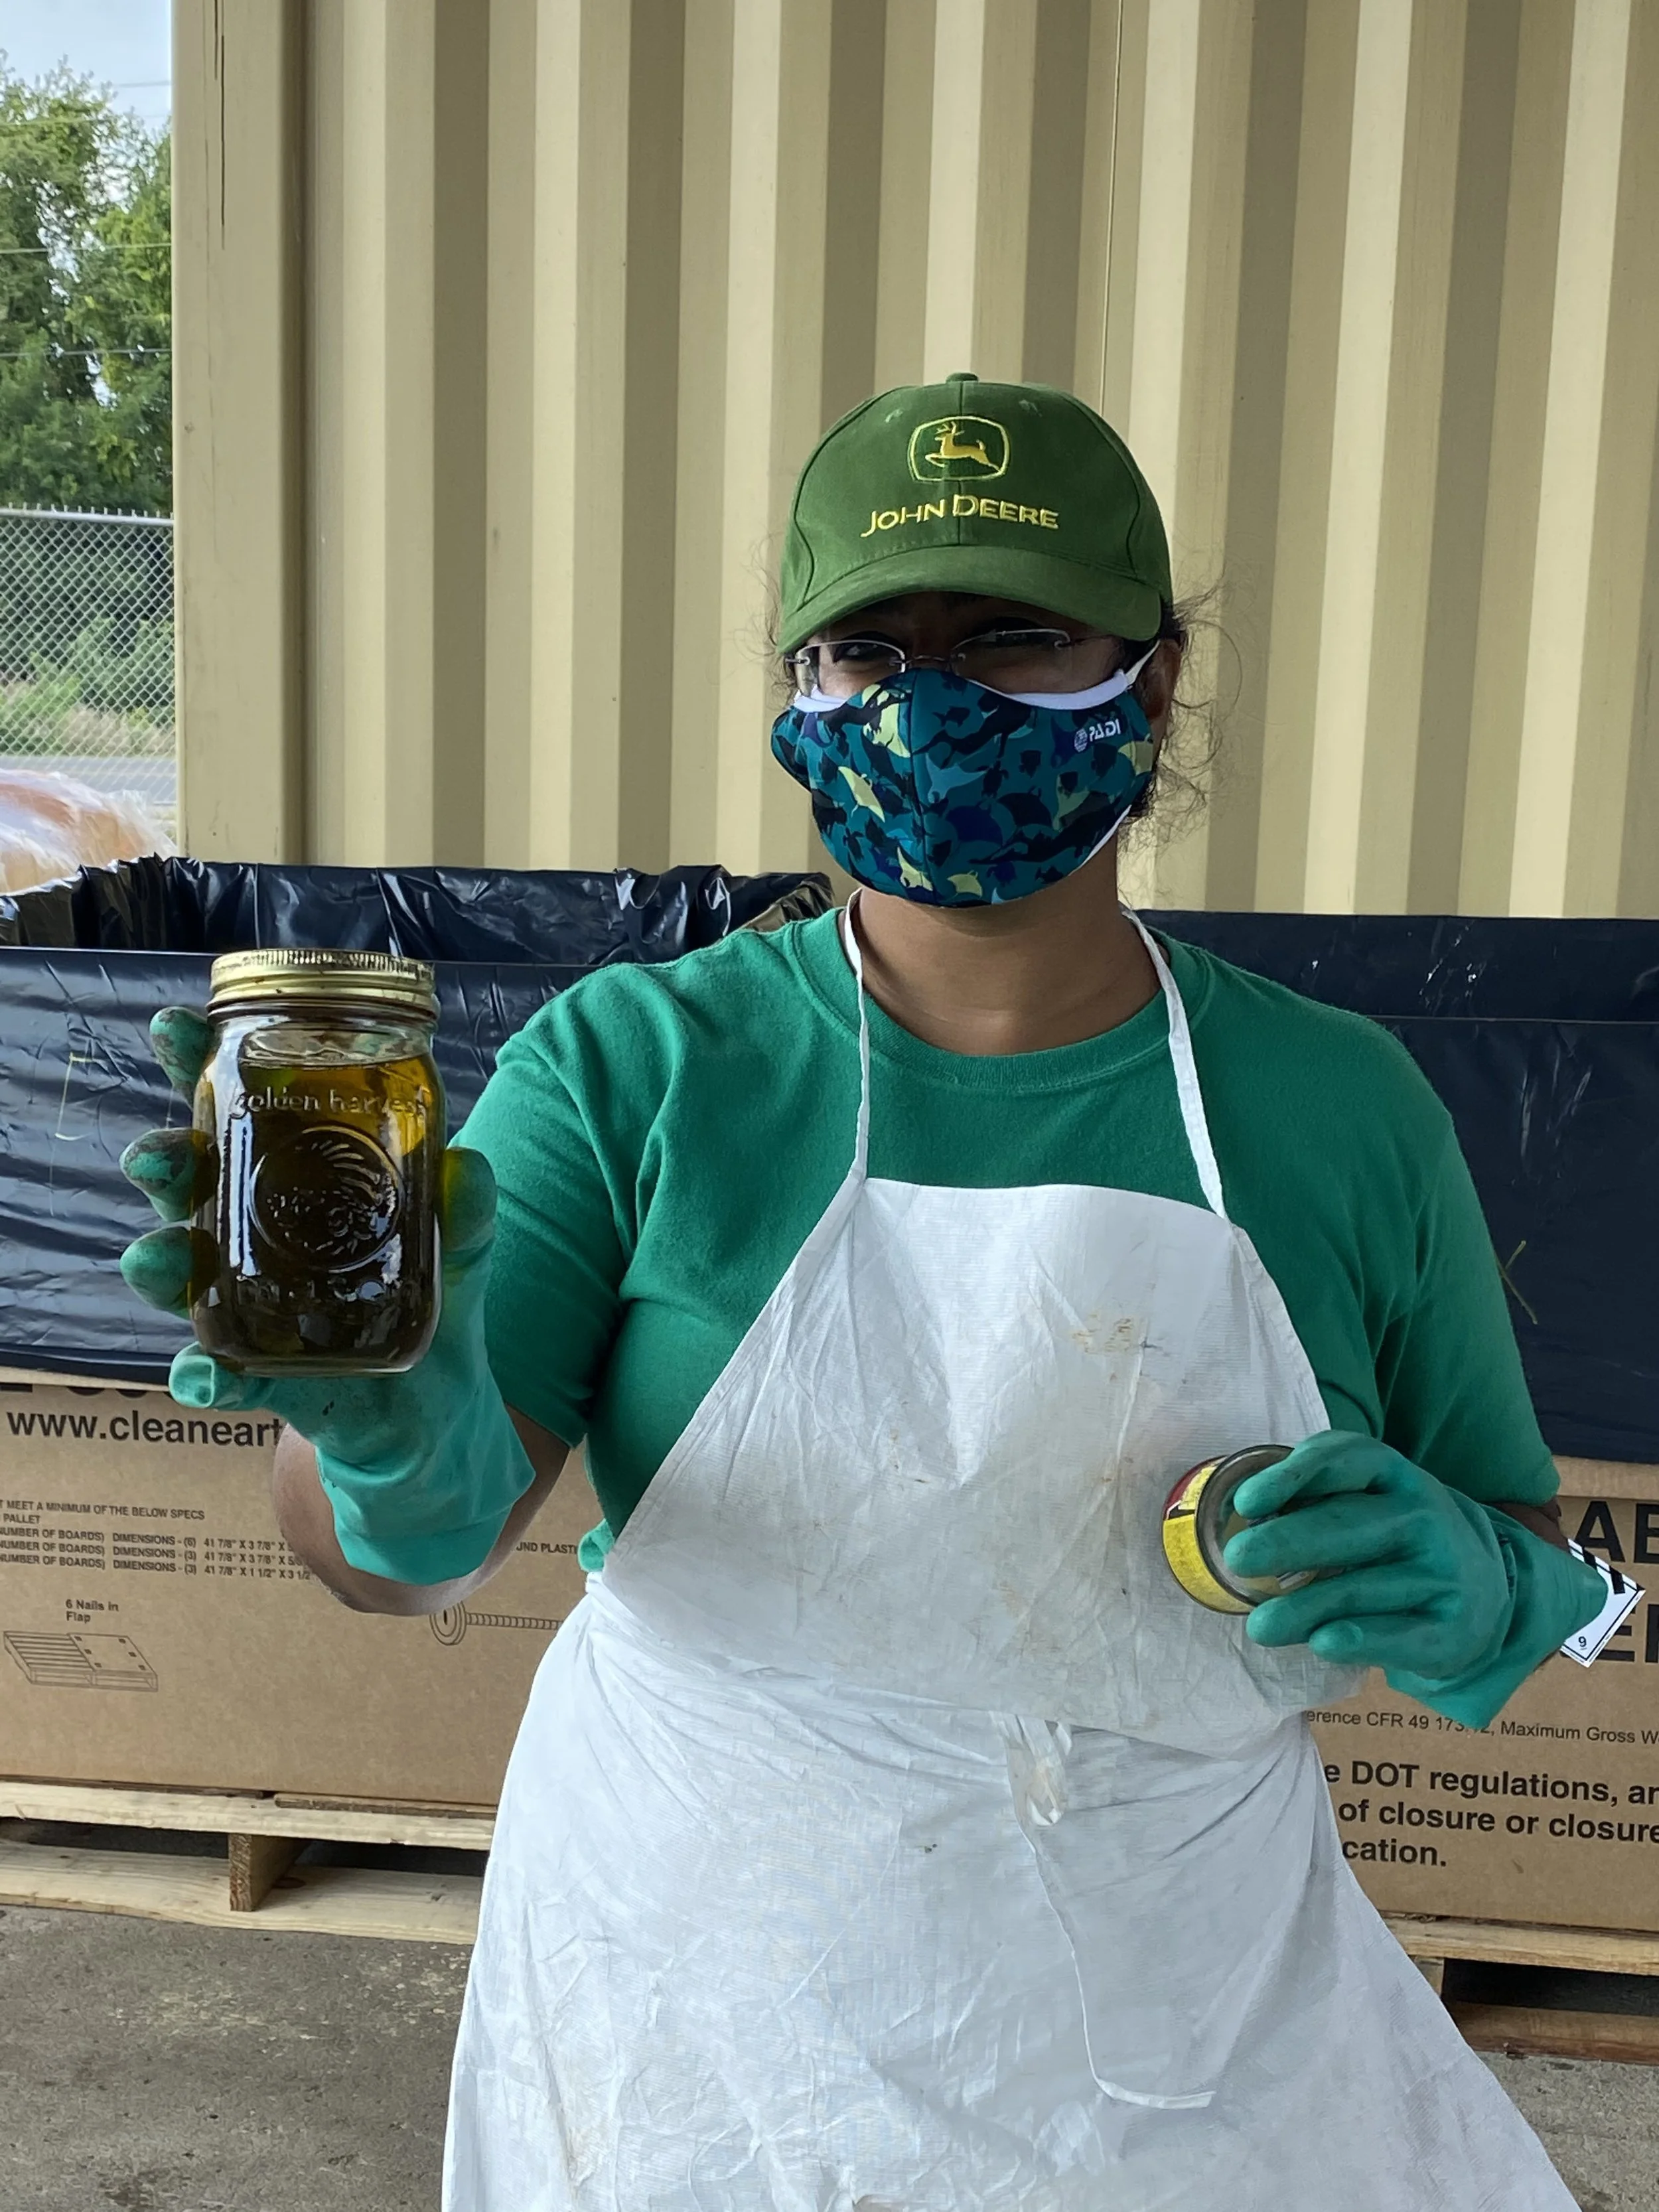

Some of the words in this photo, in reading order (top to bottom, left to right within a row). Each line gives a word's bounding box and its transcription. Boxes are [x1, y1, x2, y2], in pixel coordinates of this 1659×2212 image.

[860, 499, 946, 538] JOHN
[952, 494, 1060, 530] DEERE
[3, 1513, 40, 1524] PALLET
[6, 1500, 35, 1511] MEET
[36, 1503, 44, 1511] A
[46, 1502, 91, 1514] MINIMUM
[94, 1504, 108, 1514] OF
[109, 1505, 129, 1516] THE
[132, 1507, 168, 1518] BELOW
[171, 1509, 205, 1520] SPECS
[42, 1529, 54, 1538] OF
[58, 1530, 105, 1543] BOARDS)
[113, 1532, 175, 1545] DIMENSIONS
[204, 1537, 215, 1548] 41
[239, 1540, 246, 1549] X
[248, 1540, 254, 1550] 3
[279, 1542, 285, 1551] X
[42, 1542, 55, 1552] OF
[58, 1543, 105, 1556] BOARDS)
[113, 1546, 176, 1559] DIMENSIONS
[184, 1550, 197, 1561] (3)
[204, 1551, 215, 1561] 41
[240, 1553, 246, 1562] X
[249, 1554, 255, 1564] 3
[279, 1556, 285, 1565] X
[42, 1556, 55, 1566] OF
[59, 1557, 106, 1570] BOARDS)
[113, 1560, 177, 1572] DIMENSIONS
[184, 1564, 197, 1575] (3)
[204, 1565, 216, 1575] 41
[240, 1567, 247, 1576] X
[250, 1568, 254, 1577] 1
[279, 1570, 285, 1579] X
[288, 1570, 294, 1579] 3
[65, 1599, 73, 1609] 6
[76, 1599, 105, 1611] Nails
[66, 1611, 91, 1624] Flap
[1578, 1636, 1587, 1648] 9
[1366, 1712, 1404, 1728] CFR
[1408, 1715, 1429, 1730] 49
[1500, 1720, 1581, 1739] Maximum
[1587, 1726, 1635, 1743] Gross
[1352, 1761, 1419, 1788] DOT
[1430, 1771, 1618, 1807] regulations,
[1338, 1799, 1370, 1822] of
[1379, 1801, 1495, 1832] closure
[1506, 1815, 1540, 1834] or
